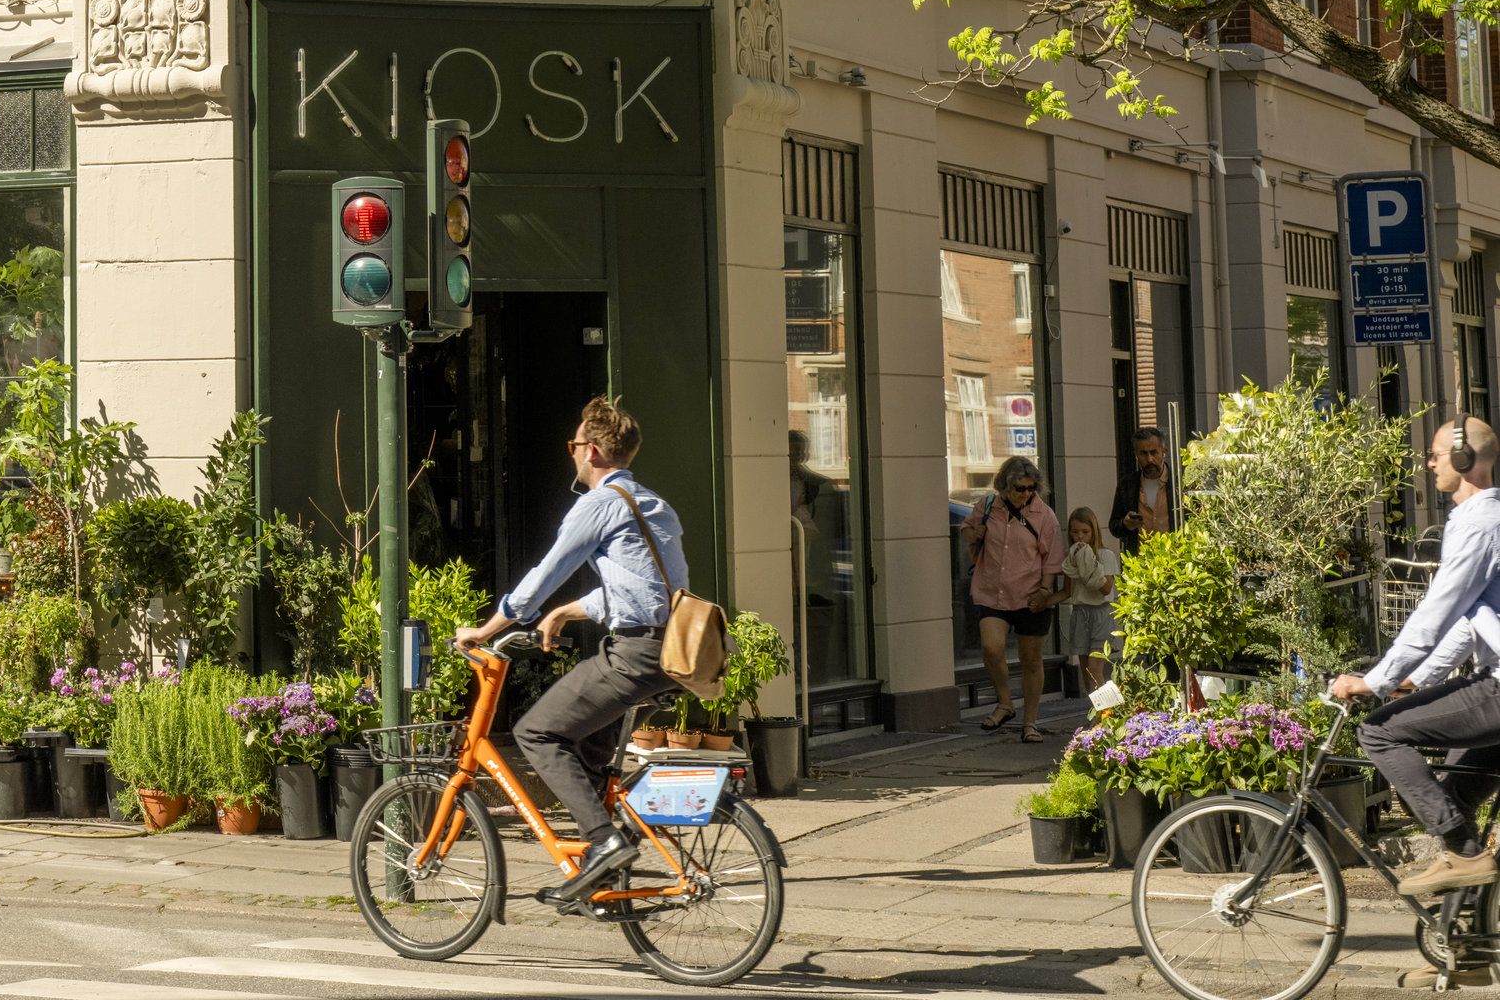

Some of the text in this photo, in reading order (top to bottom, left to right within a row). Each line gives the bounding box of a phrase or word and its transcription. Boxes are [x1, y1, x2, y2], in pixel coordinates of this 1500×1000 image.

[297, 47, 679, 144] KIOSK
[1366, 189, 1408, 247] P
[1377, 265, 1409, 274] 30 min
[1383, 275, 1403, 283] 9-18
[1380, 284, 1407, 293] (9-15)
